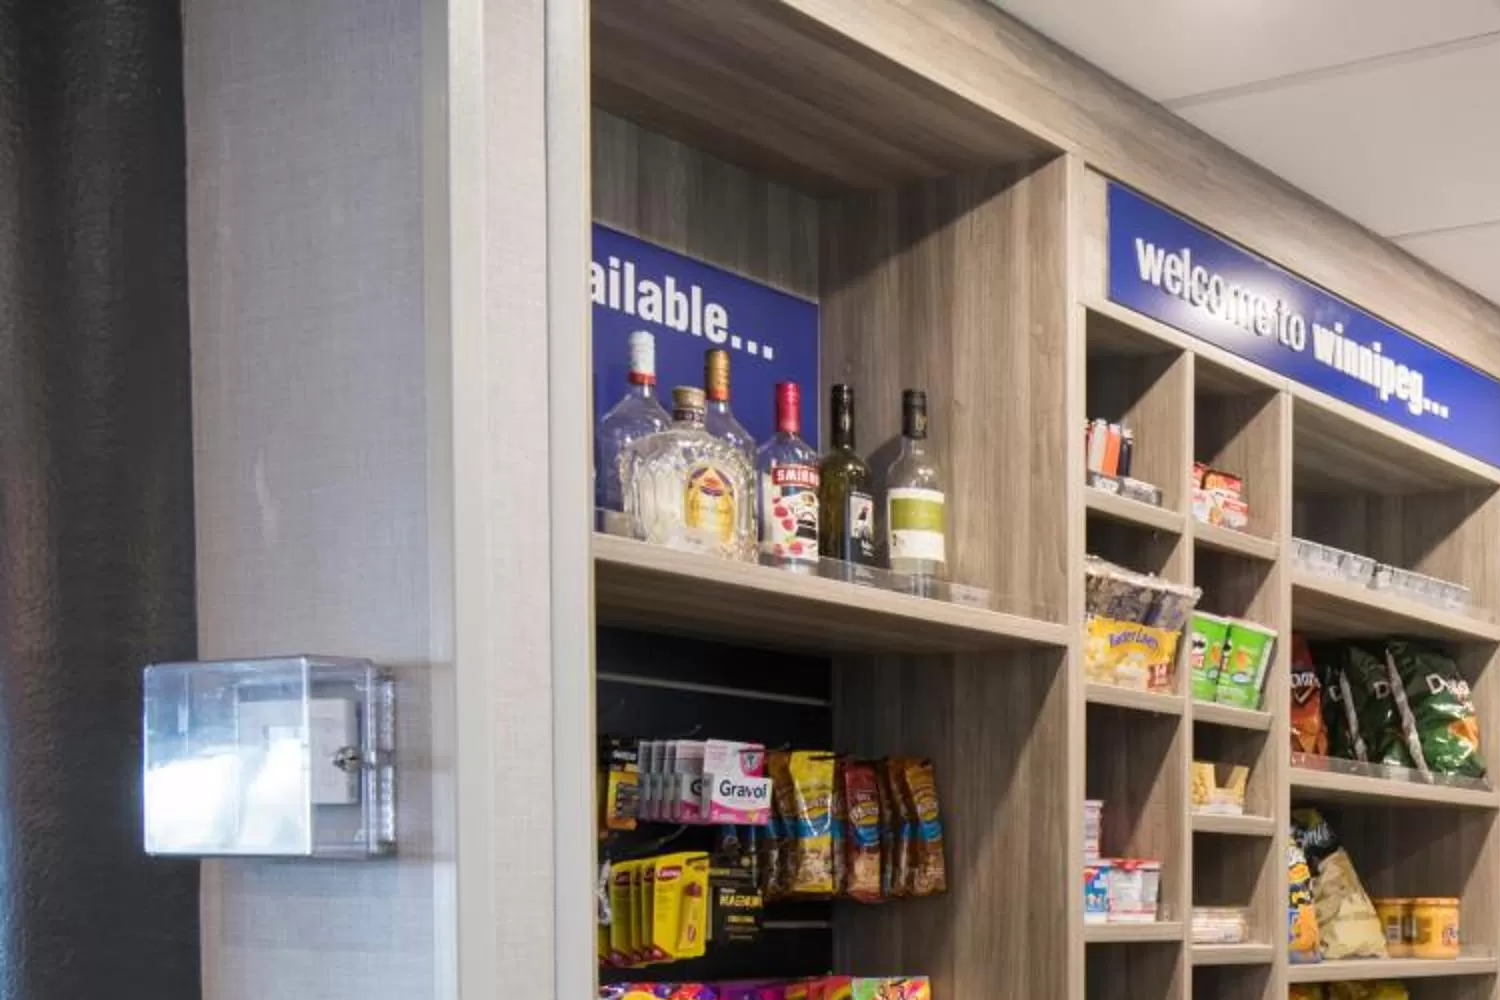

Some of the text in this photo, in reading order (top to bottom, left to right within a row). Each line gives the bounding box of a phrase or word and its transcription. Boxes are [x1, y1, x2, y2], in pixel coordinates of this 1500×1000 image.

[1136, 238, 1449, 418] welcome to winnipeg...
[719, 779, 767, 798] Gravol
